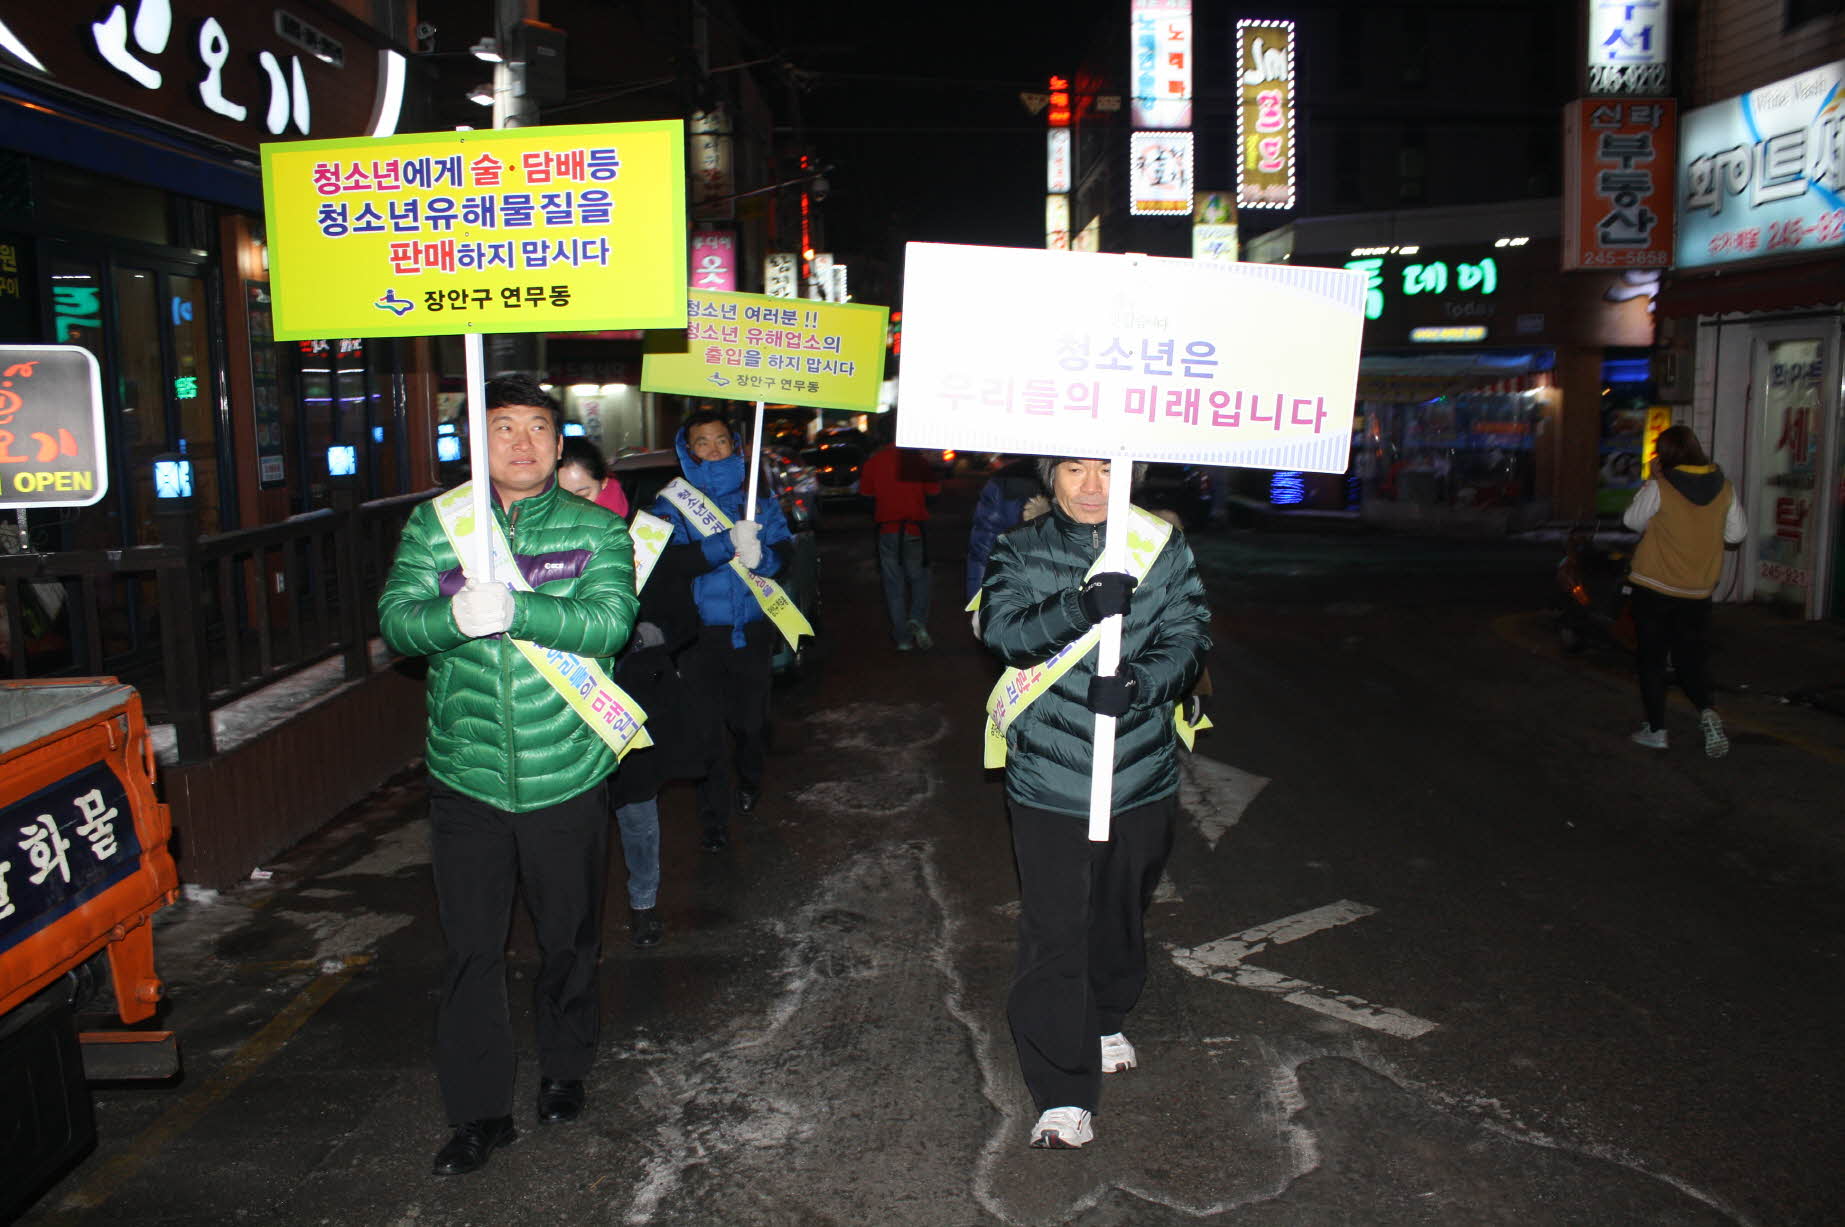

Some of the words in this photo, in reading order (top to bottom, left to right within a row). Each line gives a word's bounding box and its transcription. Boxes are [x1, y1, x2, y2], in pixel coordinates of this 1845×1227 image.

[1592, 103, 1664, 128] 신라
[312, 156, 463, 195] 청소년에게
[1597, 131, 1657, 249] 부동산
[317, 189, 614, 237] 청소년유해물질을
[389, 239, 514, 274] 판매하지
[523, 237, 609, 268] 맙시다
[1584, 250, 1667, 264] 245-5858
[424, 288, 493, 312] 장안구
[501, 285, 571, 309] 연무동
[744, 306, 798, 326] 여러분
[745, 327, 841, 354] 유해업소의
[1056, 336, 1218, 379] 청소년은
[705, 345, 761, 368] 출입을
[767, 354, 800, 371] 하지
[806, 357, 855, 377] 맙시다
[736, 374, 777, 389] 장안구
[780, 378, 820, 393] 연무동
[936, 371, 1100, 420] 우리들의
[1124, 384, 1327, 435] 미래입니다
[13, 471, 93, 493] OPEN
[676, 489, 727, 534] 청소년에게
[546, 649, 598, 700] 우리들의
